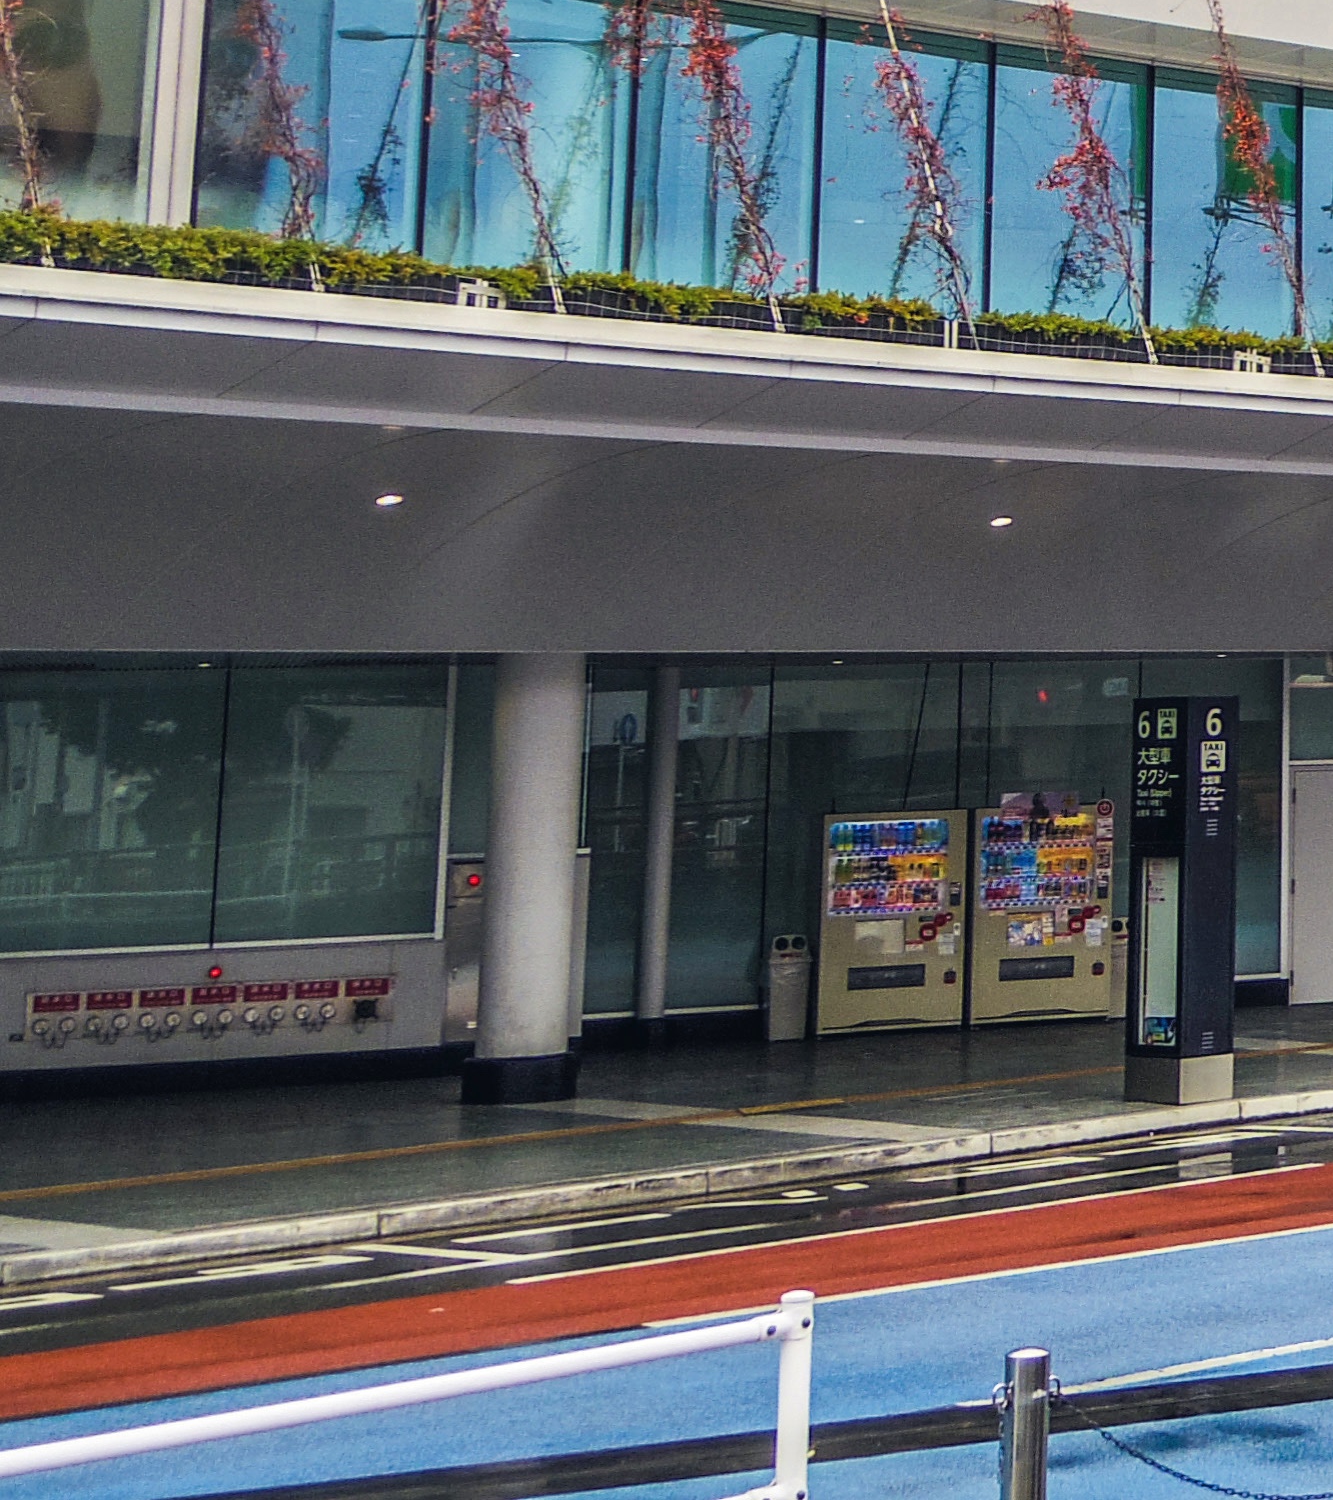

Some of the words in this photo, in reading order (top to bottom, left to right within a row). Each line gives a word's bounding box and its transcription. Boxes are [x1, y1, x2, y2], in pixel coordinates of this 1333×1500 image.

[1138, 710, 1150, 738] 6
[1159, 710, 1176, 718] TAXI
[1206, 708, 1222, 736] 6
[1203, 742, 1223, 750] TAXI
[1137, 747, 1171, 765] 大型車
[1137, 769, 1179, 785] タクシー
